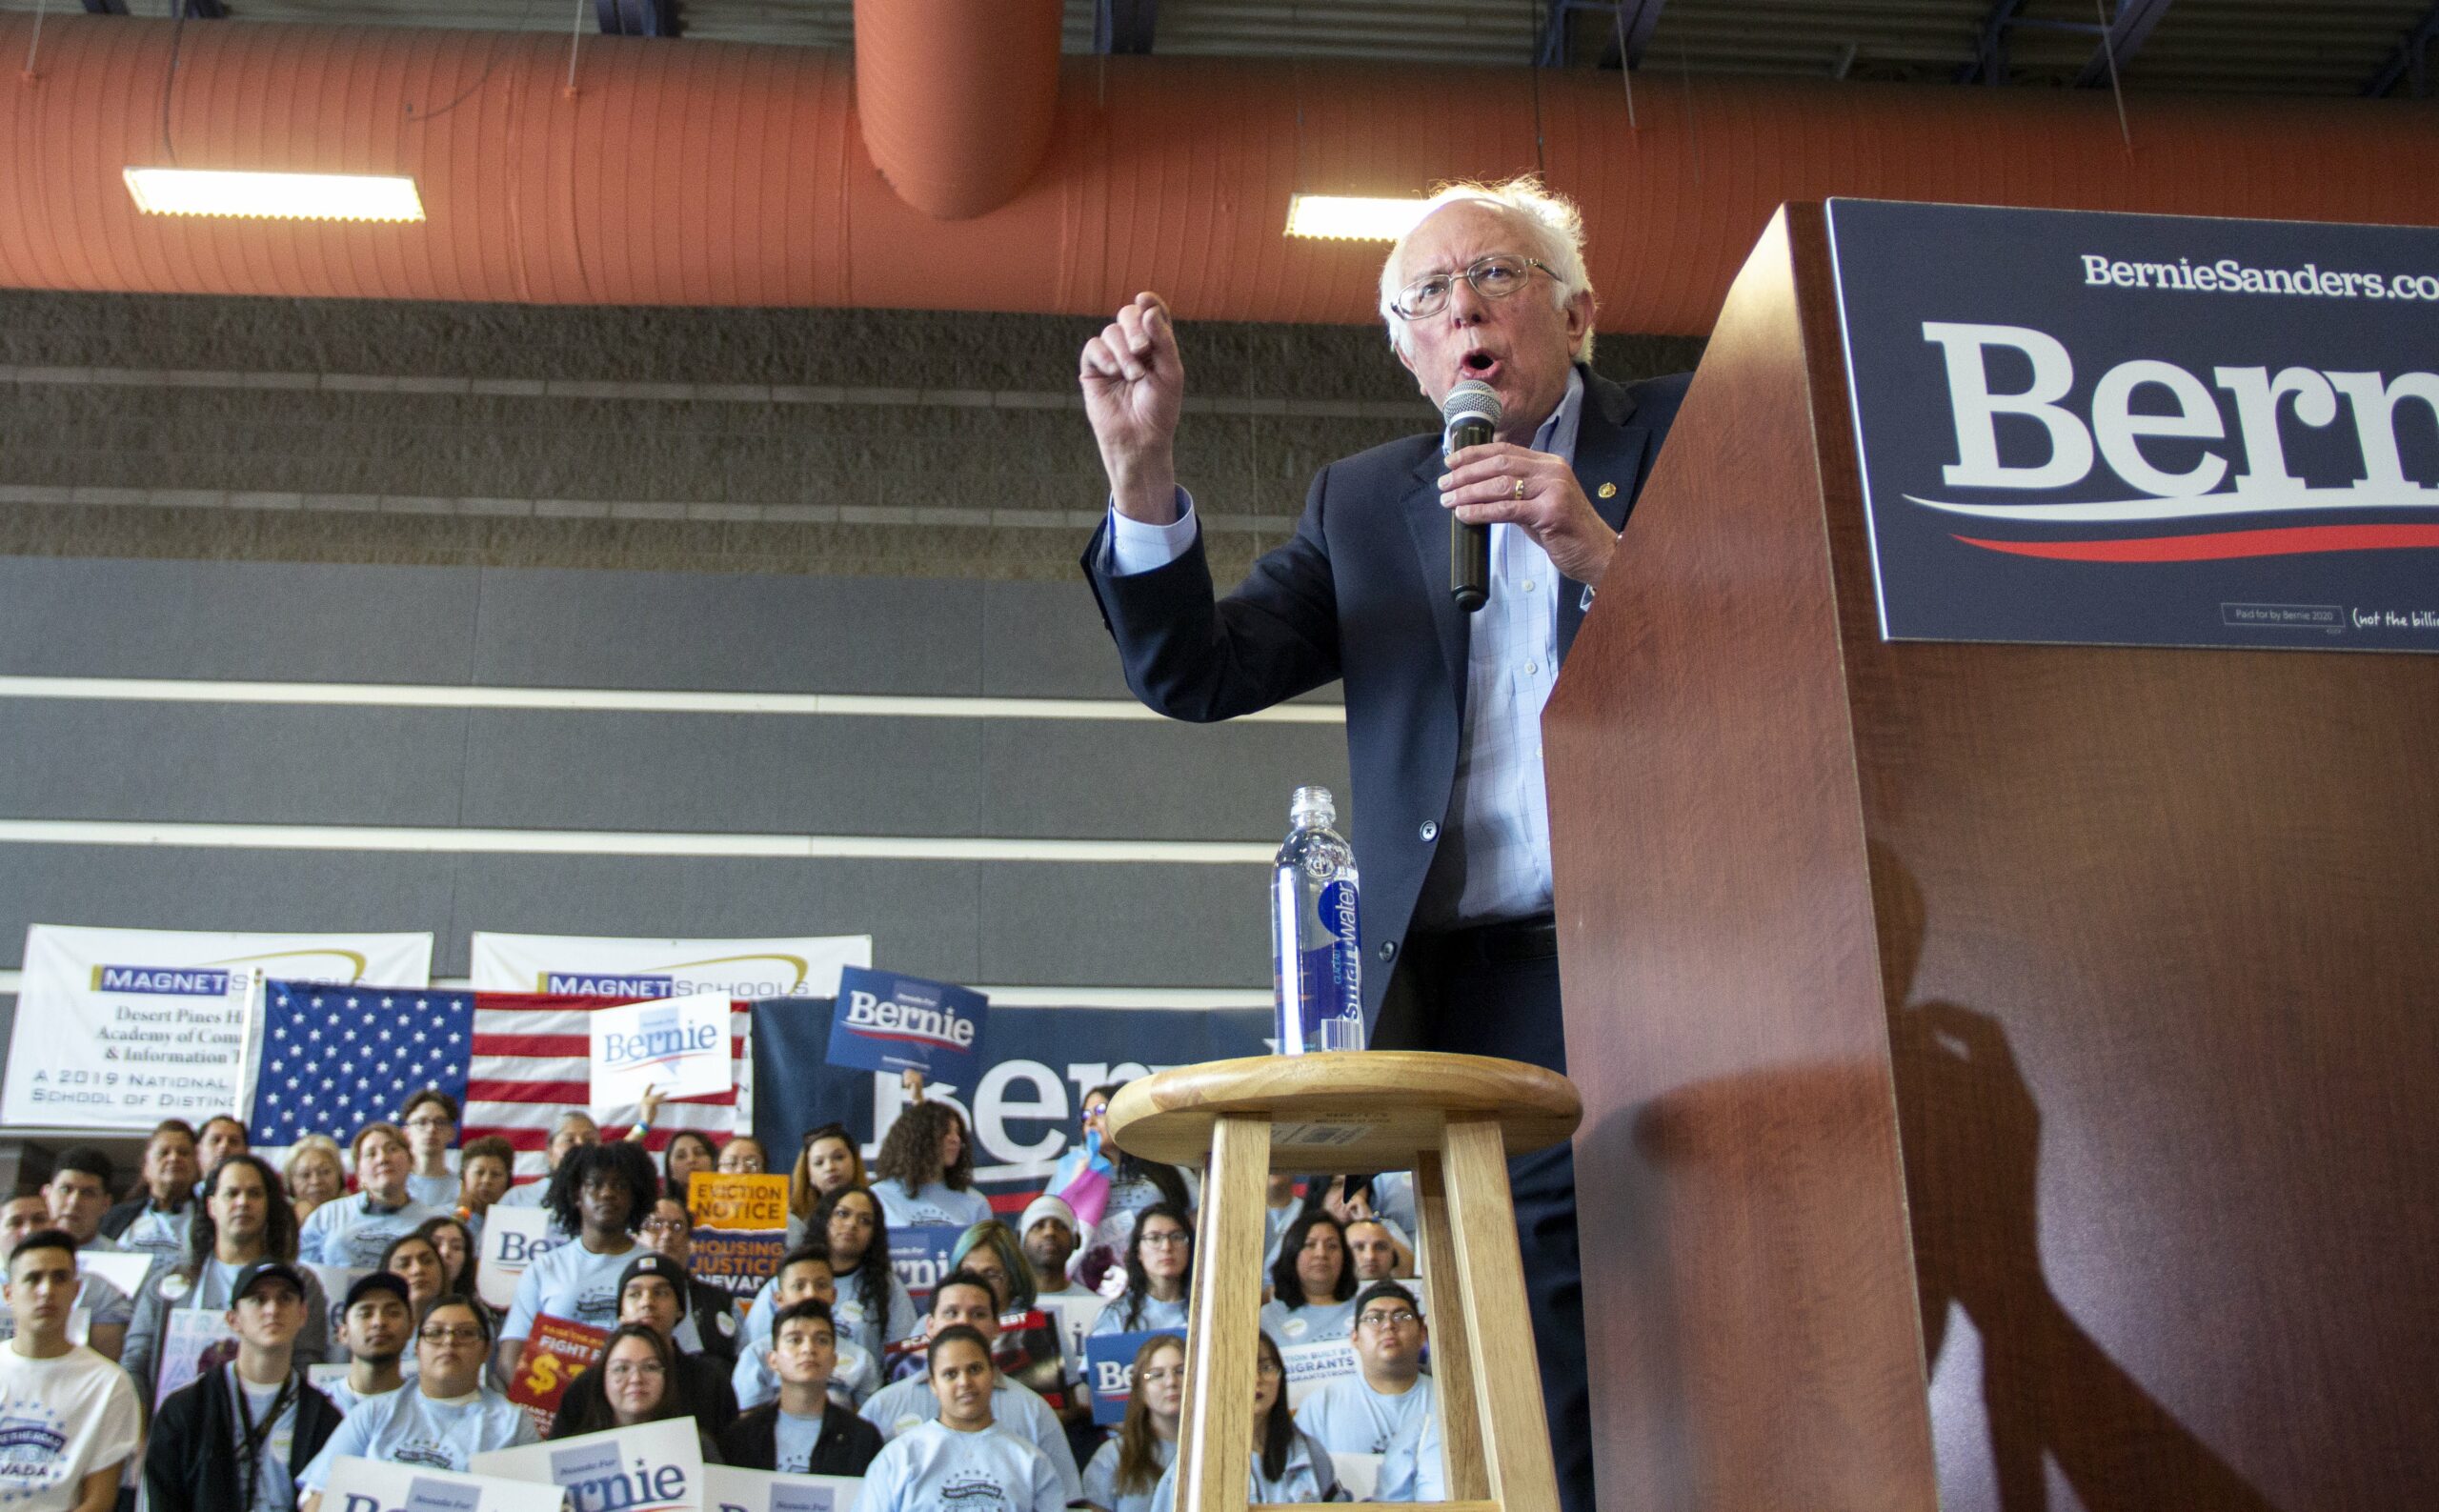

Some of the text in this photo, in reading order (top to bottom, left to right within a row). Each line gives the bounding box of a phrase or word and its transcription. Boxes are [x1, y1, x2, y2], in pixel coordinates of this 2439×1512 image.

[2235, 609, 2334, 621] Paid for by Bernie 2020
[2352, 607, 2439, 629] (not the billi
[103, 969, 227, 994] MAGNET
[550, 976, 672, 997] MAGNET
[116, 1005, 172, 1023] Desert
[175, 1008, 222, 1024] Pines
[846, 990, 976, 1048] Bernie
[96, 1025, 171, 1045] Academy
[176, 1028, 197, 1043] of
[603, 1018, 717, 1063] Bernie
[104, 1048, 120, 1060] &
[123, 1049, 229, 1064] Information
[33, 1069, 231, 1089] A 2019 NATIONAL
[30, 1088, 115, 1104] SCHOOL
[124, 1094, 149, 1106] OF
[696, 1184, 782, 1200] EVICTION
[695, 1200, 781, 1220] NOTICE
[496, 1231, 569, 1260] Be
[692, 1240, 785, 1257] HOUSING
[538, 1334, 591, 1358] FIGHT
